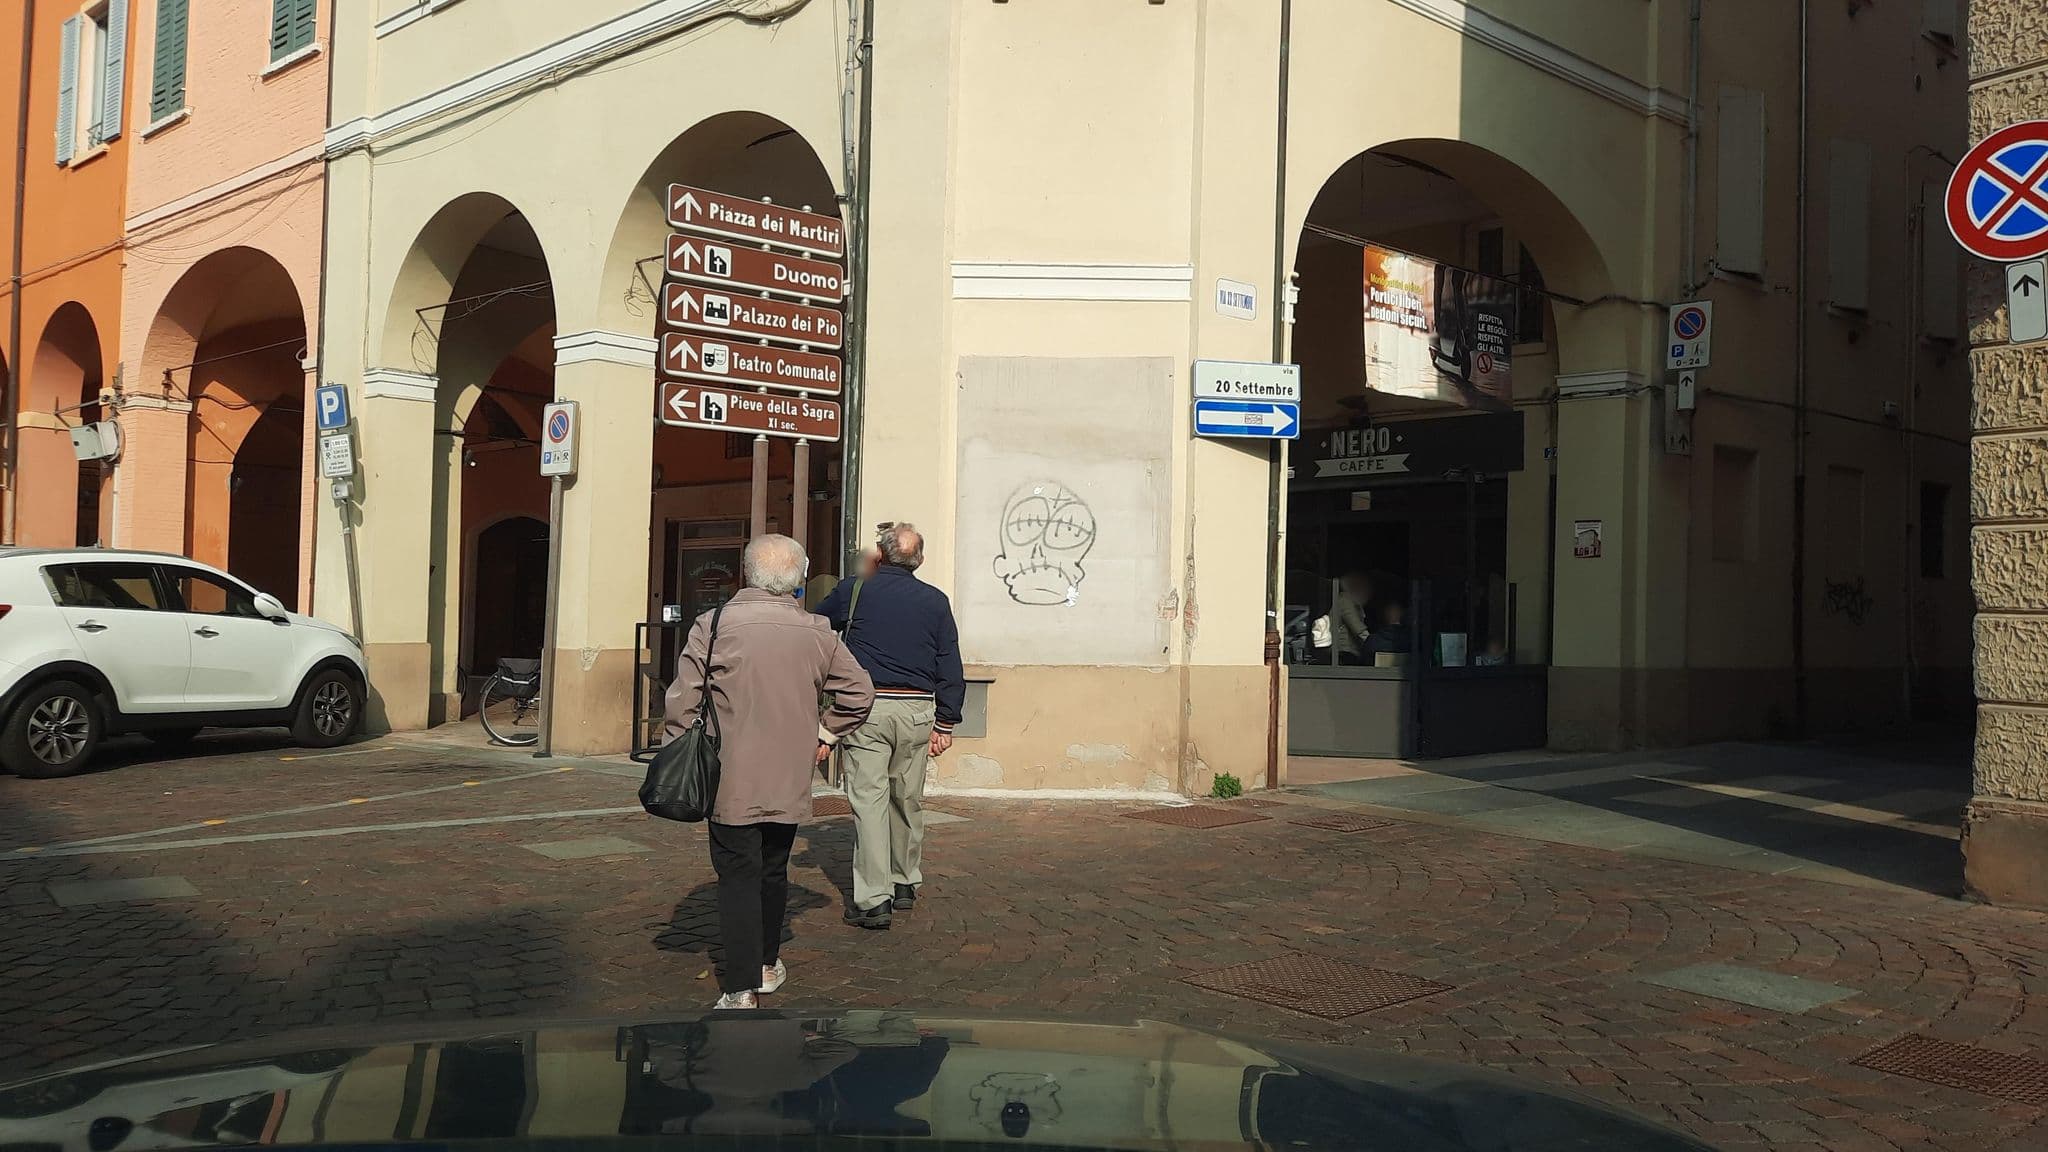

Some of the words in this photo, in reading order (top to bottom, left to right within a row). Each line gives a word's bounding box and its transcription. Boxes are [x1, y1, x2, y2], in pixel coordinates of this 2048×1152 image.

[709, 202, 756, 228] Piazza
[761, 214, 784, 233] dei
[789, 218, 839, 244] Martiri
[773, 263, 838, 290] Duomo
[1370, 286, 1398, 306] Portici
[733, 304, 786, 328] Palazzo
[791, 314, 811, 332] dei
[817, 317, 837, 336] Pio
[1370, 306, 1399, 324] pedoni
[1478, 313, 1503, 326] RISPETTA
[1478, 323, 1485, 332] LE
[1477, 332, 1503, 345] RISPETTA
[1477, 342, 1488, 352] GLI
[1674, 346, 1682, 355] P
[732, 352, 772, 374] Teatro
[776, 358, 837, 382] Comunale
[1215, 380, 1231, 393] 20
[1235, 381, 1294, 396] Settembre
[321, 391, 339, 425] P
[730, 395, 763, 411] Pieve
[767, 399, 798, 416] della
[802, 403, 835, 421] Sagra
[768, 417, 778, 428] XI
[781, 421, 798, 431] sec.
[1330, 427, 1390, 458] NERO
[545, 453, 550, 463] P
